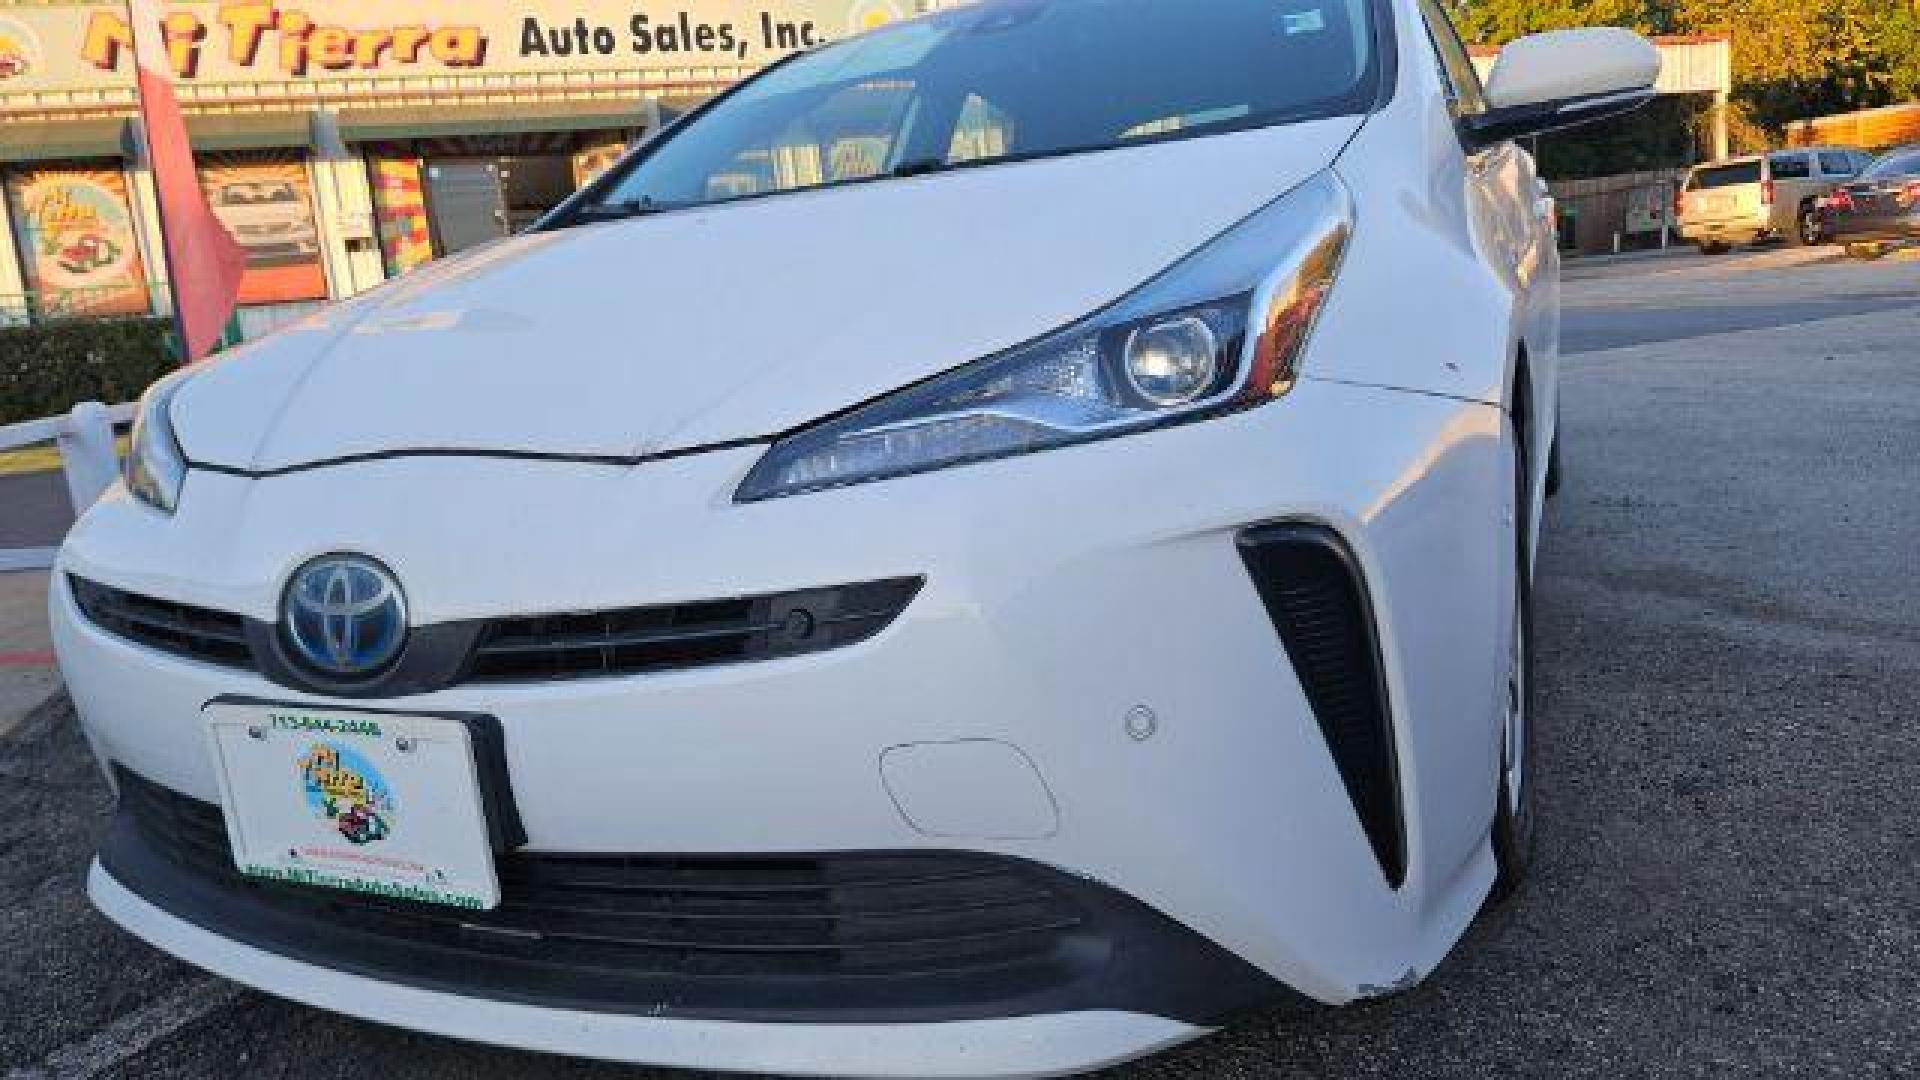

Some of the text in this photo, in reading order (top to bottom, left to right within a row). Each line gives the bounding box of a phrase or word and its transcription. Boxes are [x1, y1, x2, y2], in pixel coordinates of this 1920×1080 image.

[217, 2, 487, 76] Tierra
[520, 12, 826, 60] Auto Sales, Inc.
